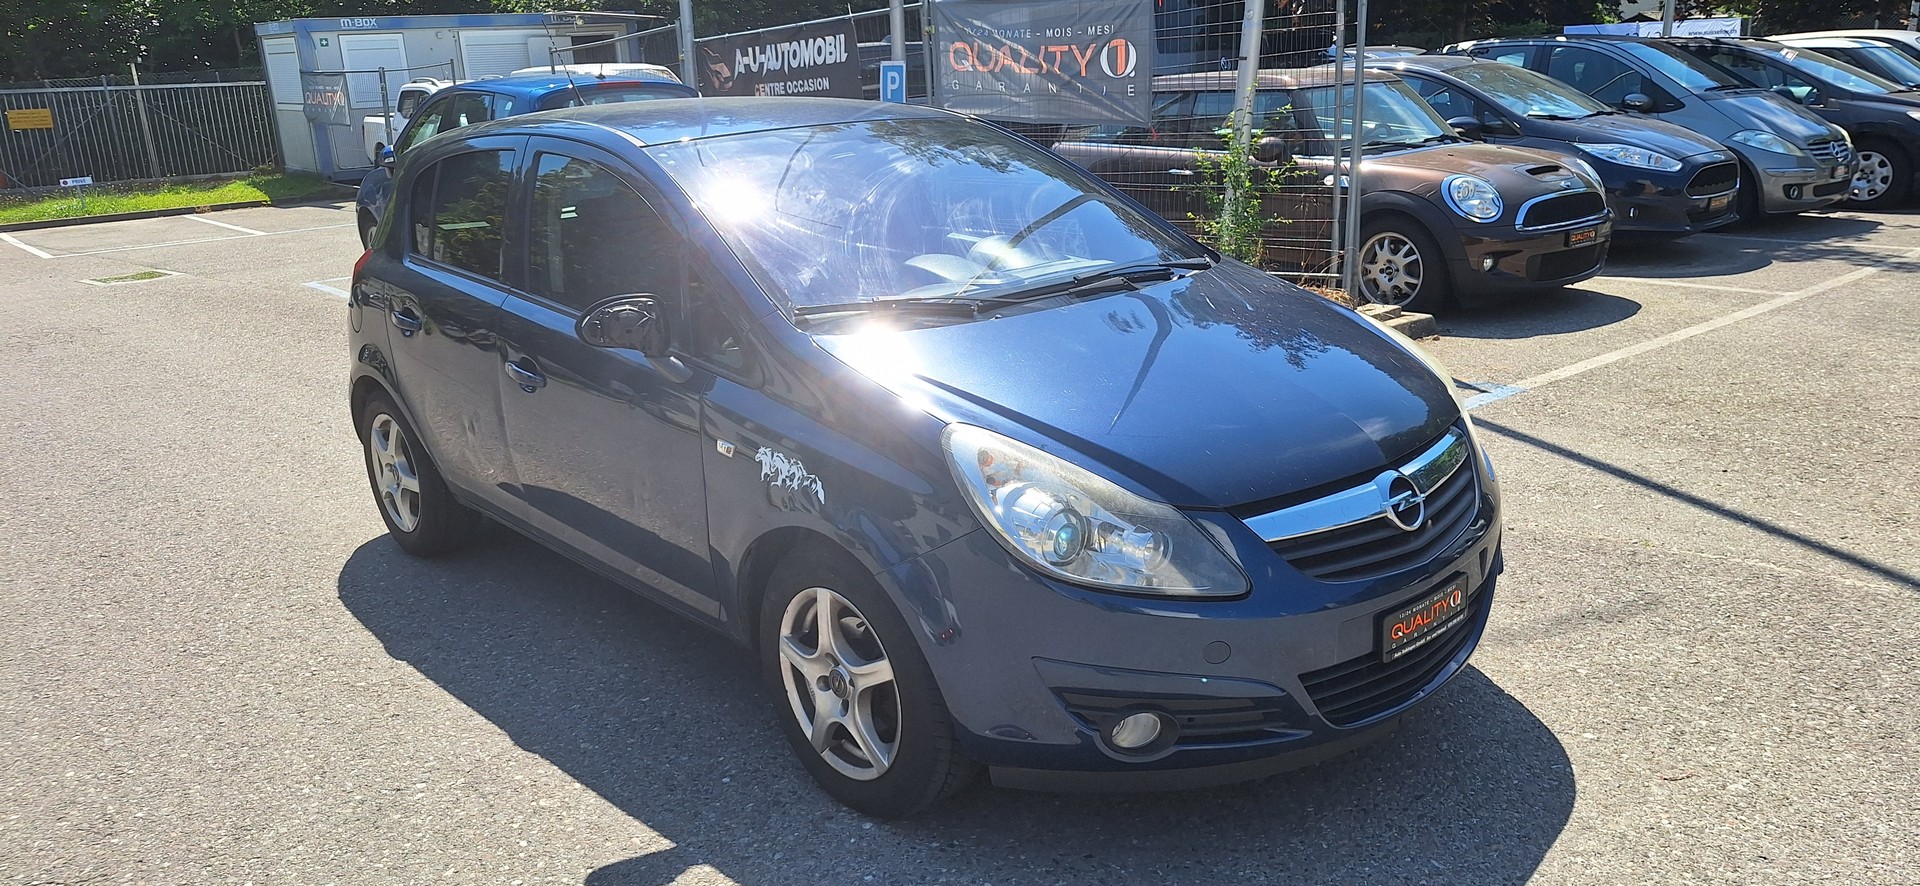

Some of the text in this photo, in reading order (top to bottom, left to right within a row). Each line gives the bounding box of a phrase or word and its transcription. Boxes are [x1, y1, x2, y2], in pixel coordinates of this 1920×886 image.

[1045, 27, 1072, 38] MOIS
[1087, 24, 1114, 35] MESI
[734, 33, 849, 80] A-U-AUTOMOBIL
[949, 40, 1097, 77] QUALITY
[305, 91, 338, 106] QUALITY
[754, 77, 830, 97] CENTRE OCCASION
[887, 71, 900, 99] P
[1391, 595, 1450, 640] QUALITY
